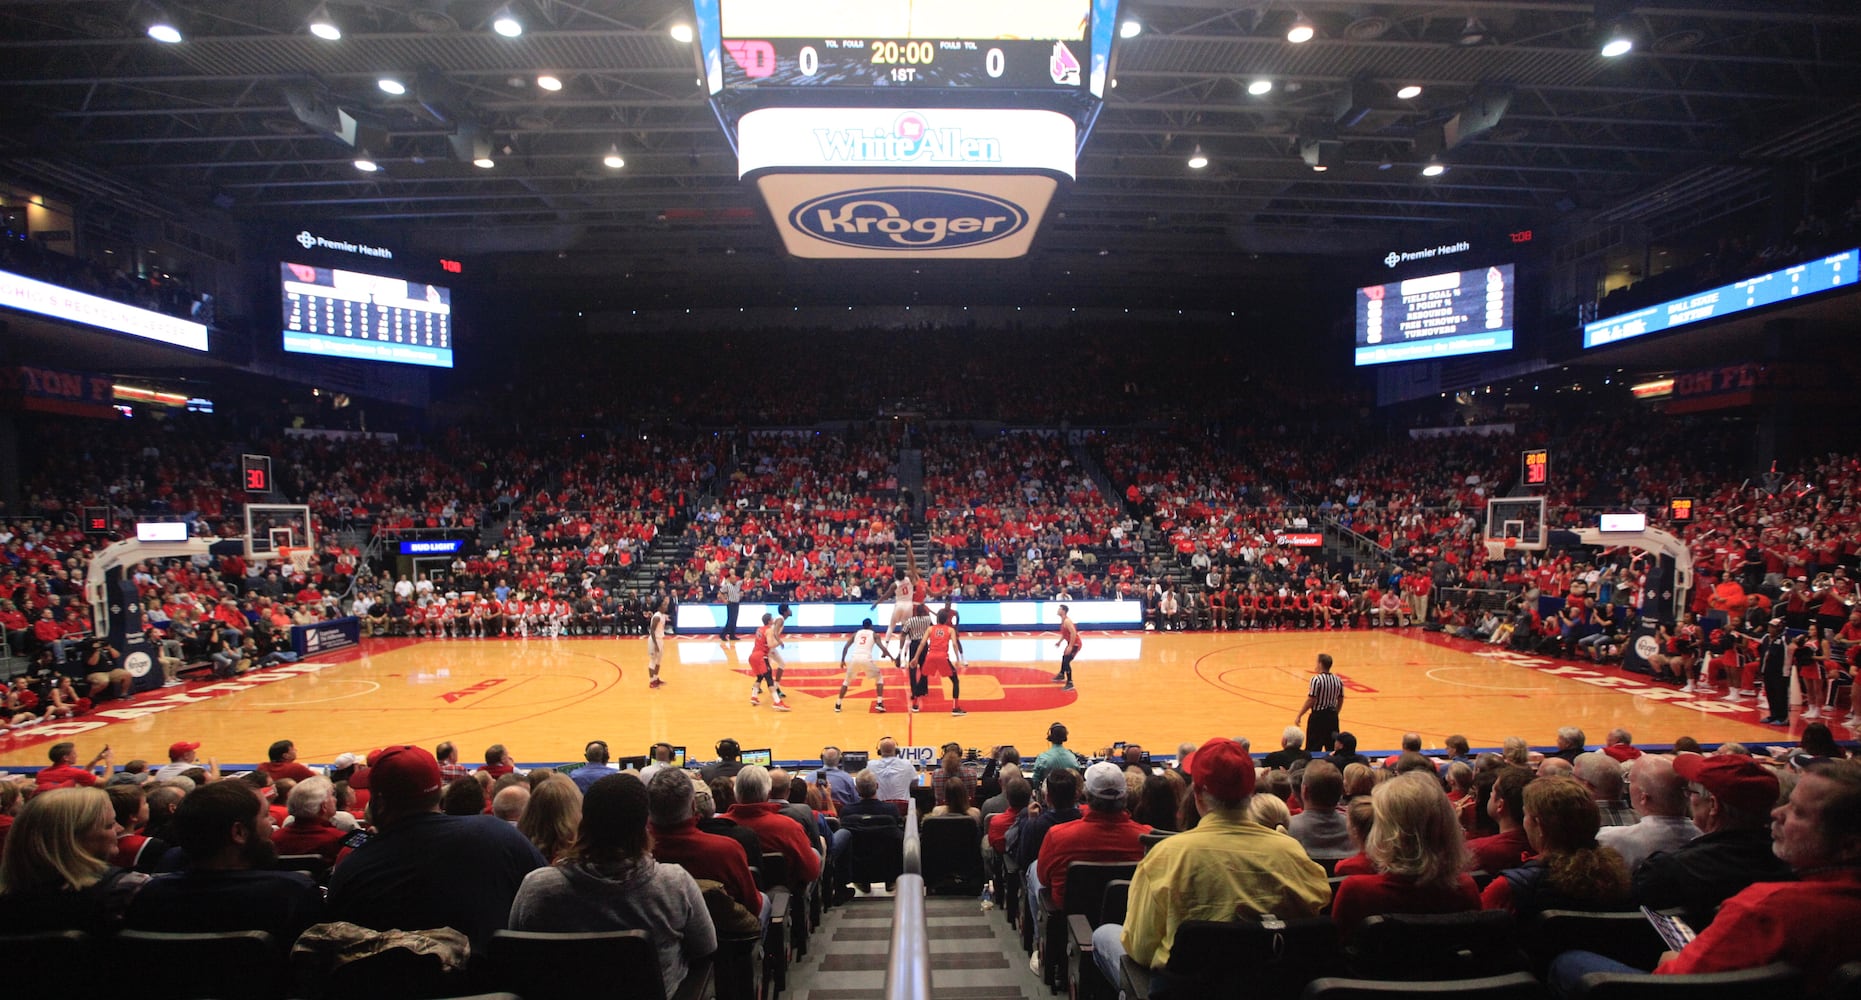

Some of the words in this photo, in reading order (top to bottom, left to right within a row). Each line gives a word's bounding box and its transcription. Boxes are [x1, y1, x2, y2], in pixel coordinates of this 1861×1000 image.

[799, 46, 819, 76] 0
[871, 41, 935, 64] 20:00
[985, 47, 1005, 78] 0
[890, 68, 916, 82] 1ST
[813, 127, 915, 162] White
[914, 127, 1002, 162] Allen
[816, 200, 1007, 245] Kroger
[316, 237, 358, 253] Premier
[359, 244, 393, 260] Health
[1400, 247, 1437, 262] Premier
[1437, 241, 1470, 255] Health
[0, 283, 58, 307] OHIOS
[1402, 293, 1427, 305] FIELD
[1428, 290, 1452, 300] GOAL
[1416, 299, 1442, 311] POINT
[1690, 293, 1720, 308] STATE
[1400, 321, 1423, 331] FREE
[1423, 315, 1461, 327] THROWS
[1406, 307, 1453, 321] REBOUNDS
[1405, 325, 1456, 339] TURNOVERS
[247, 469, 265, 489] 30
[1528, 463, 1544, 483] 30
[1674, 508, 1689, 519] 30
[411, 543, 430, 552] BUD
[430, 542, 455, 552] LIGHT
[1276, 535, 1318, 545] Budweiser
[859, 636, 867, 645] 3
[1471, 650, 1756, 714] FLYERS
[13, 662, 337, 738] DAYTON
